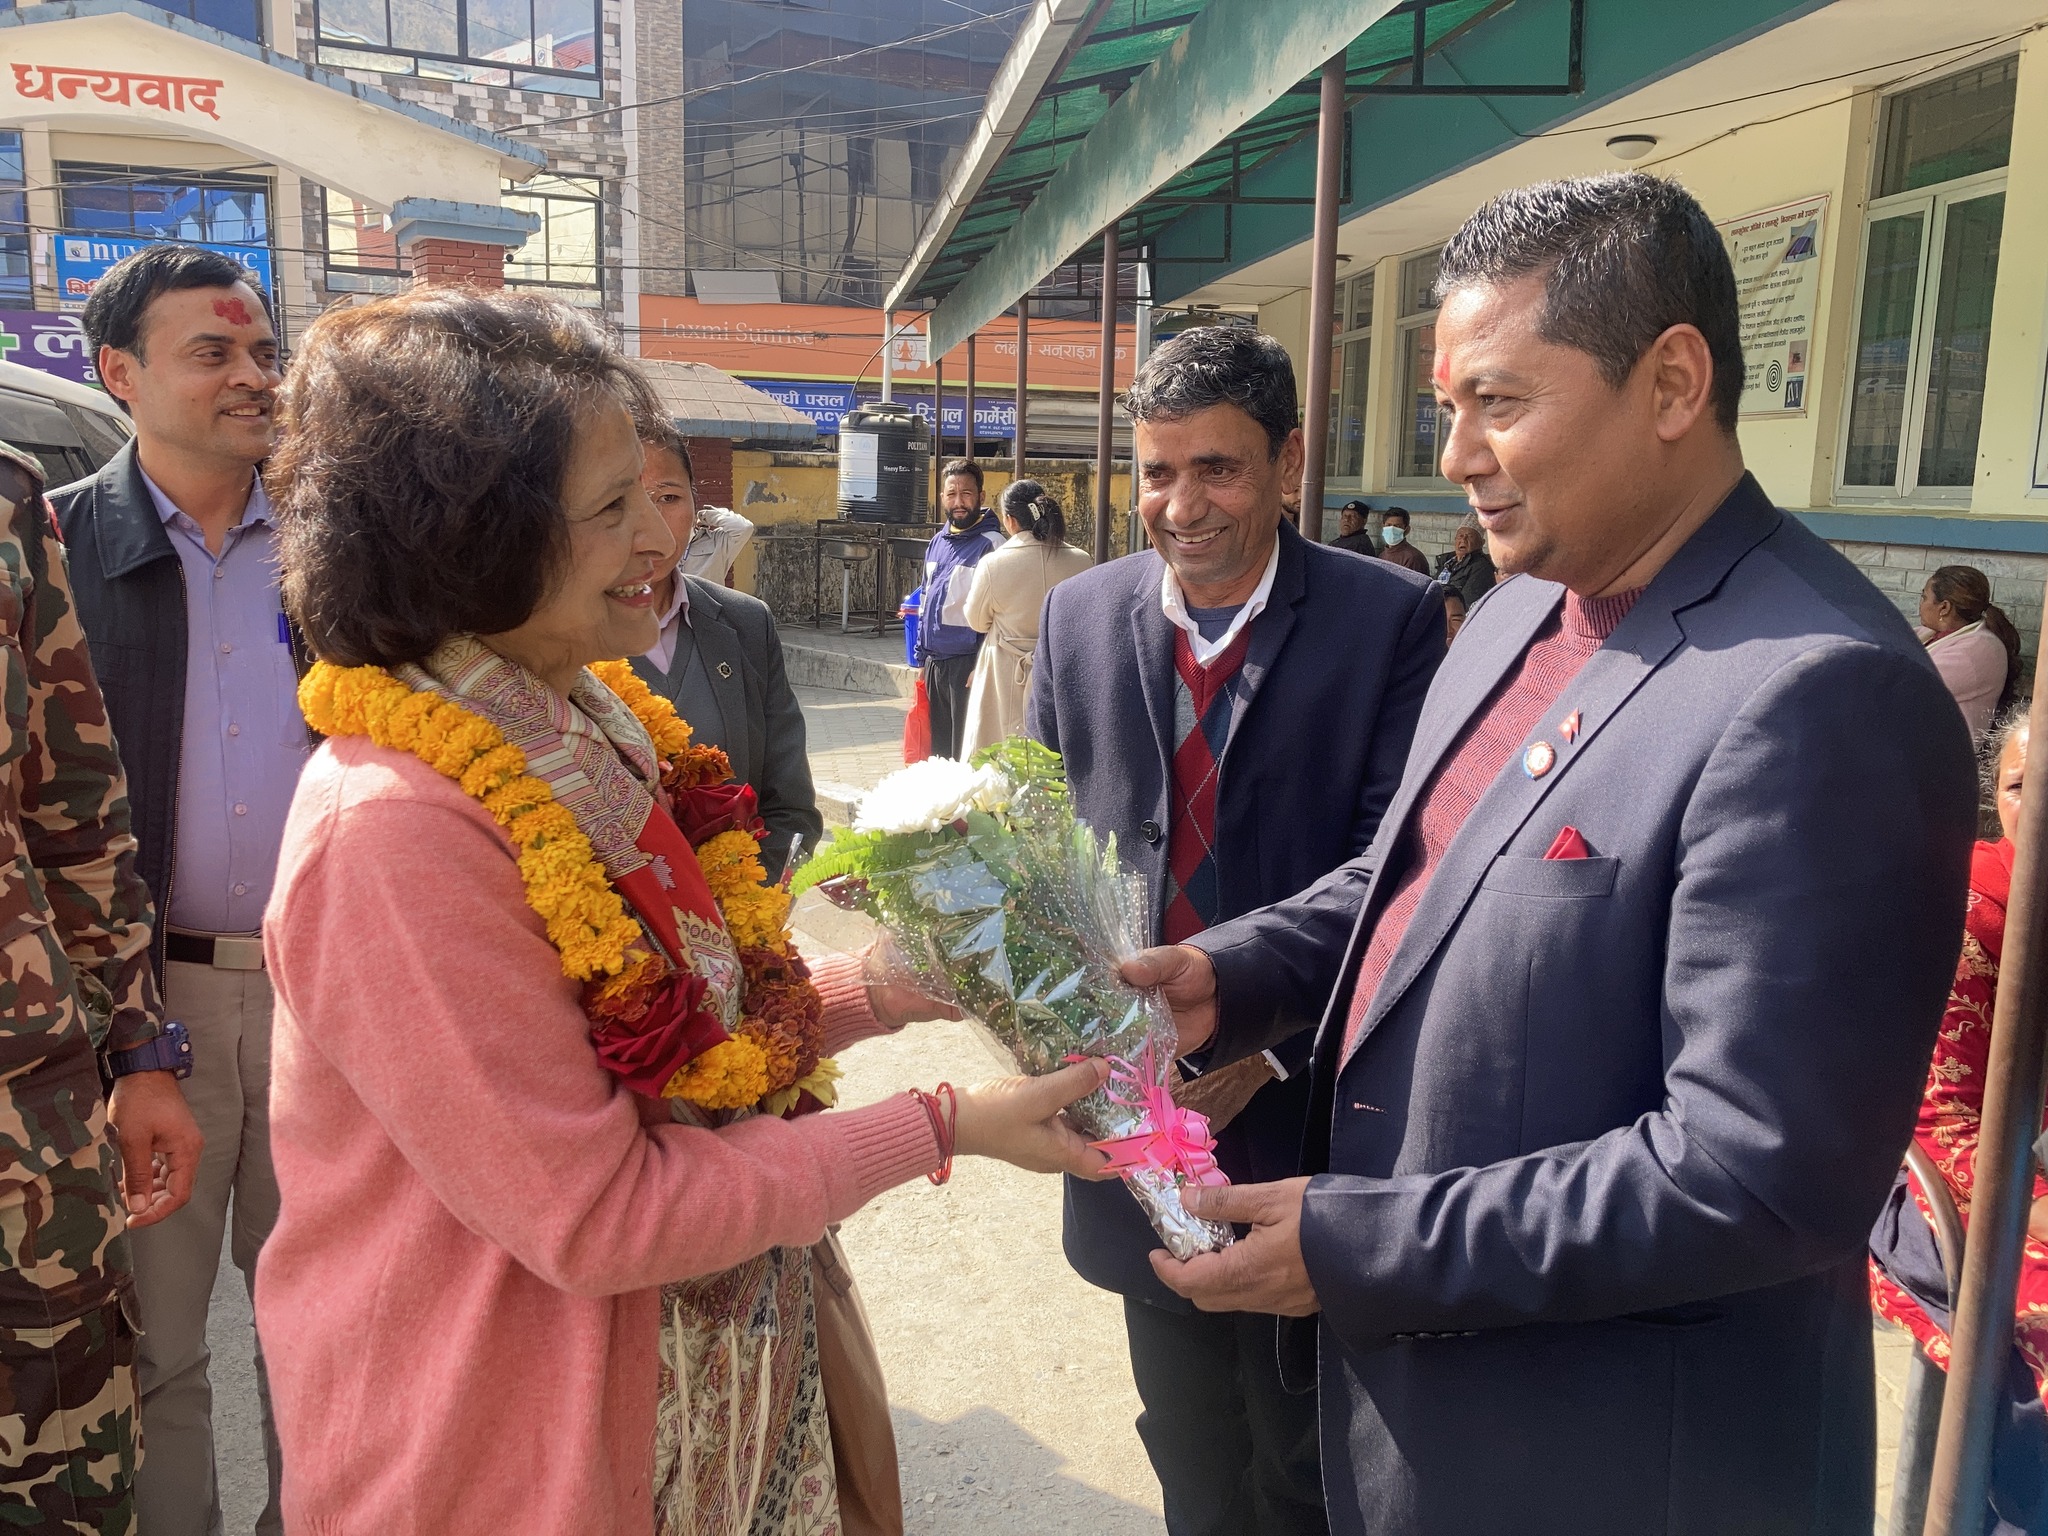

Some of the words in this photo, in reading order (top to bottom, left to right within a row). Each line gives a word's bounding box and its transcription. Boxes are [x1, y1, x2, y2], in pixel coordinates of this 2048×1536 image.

[10, 62, 224, 121] धन्यवाद
[661, 317, 729, 339] Laxmi
[735, 322, 816, 346] Sunrise
[805, 394, 845, 407] पसल
